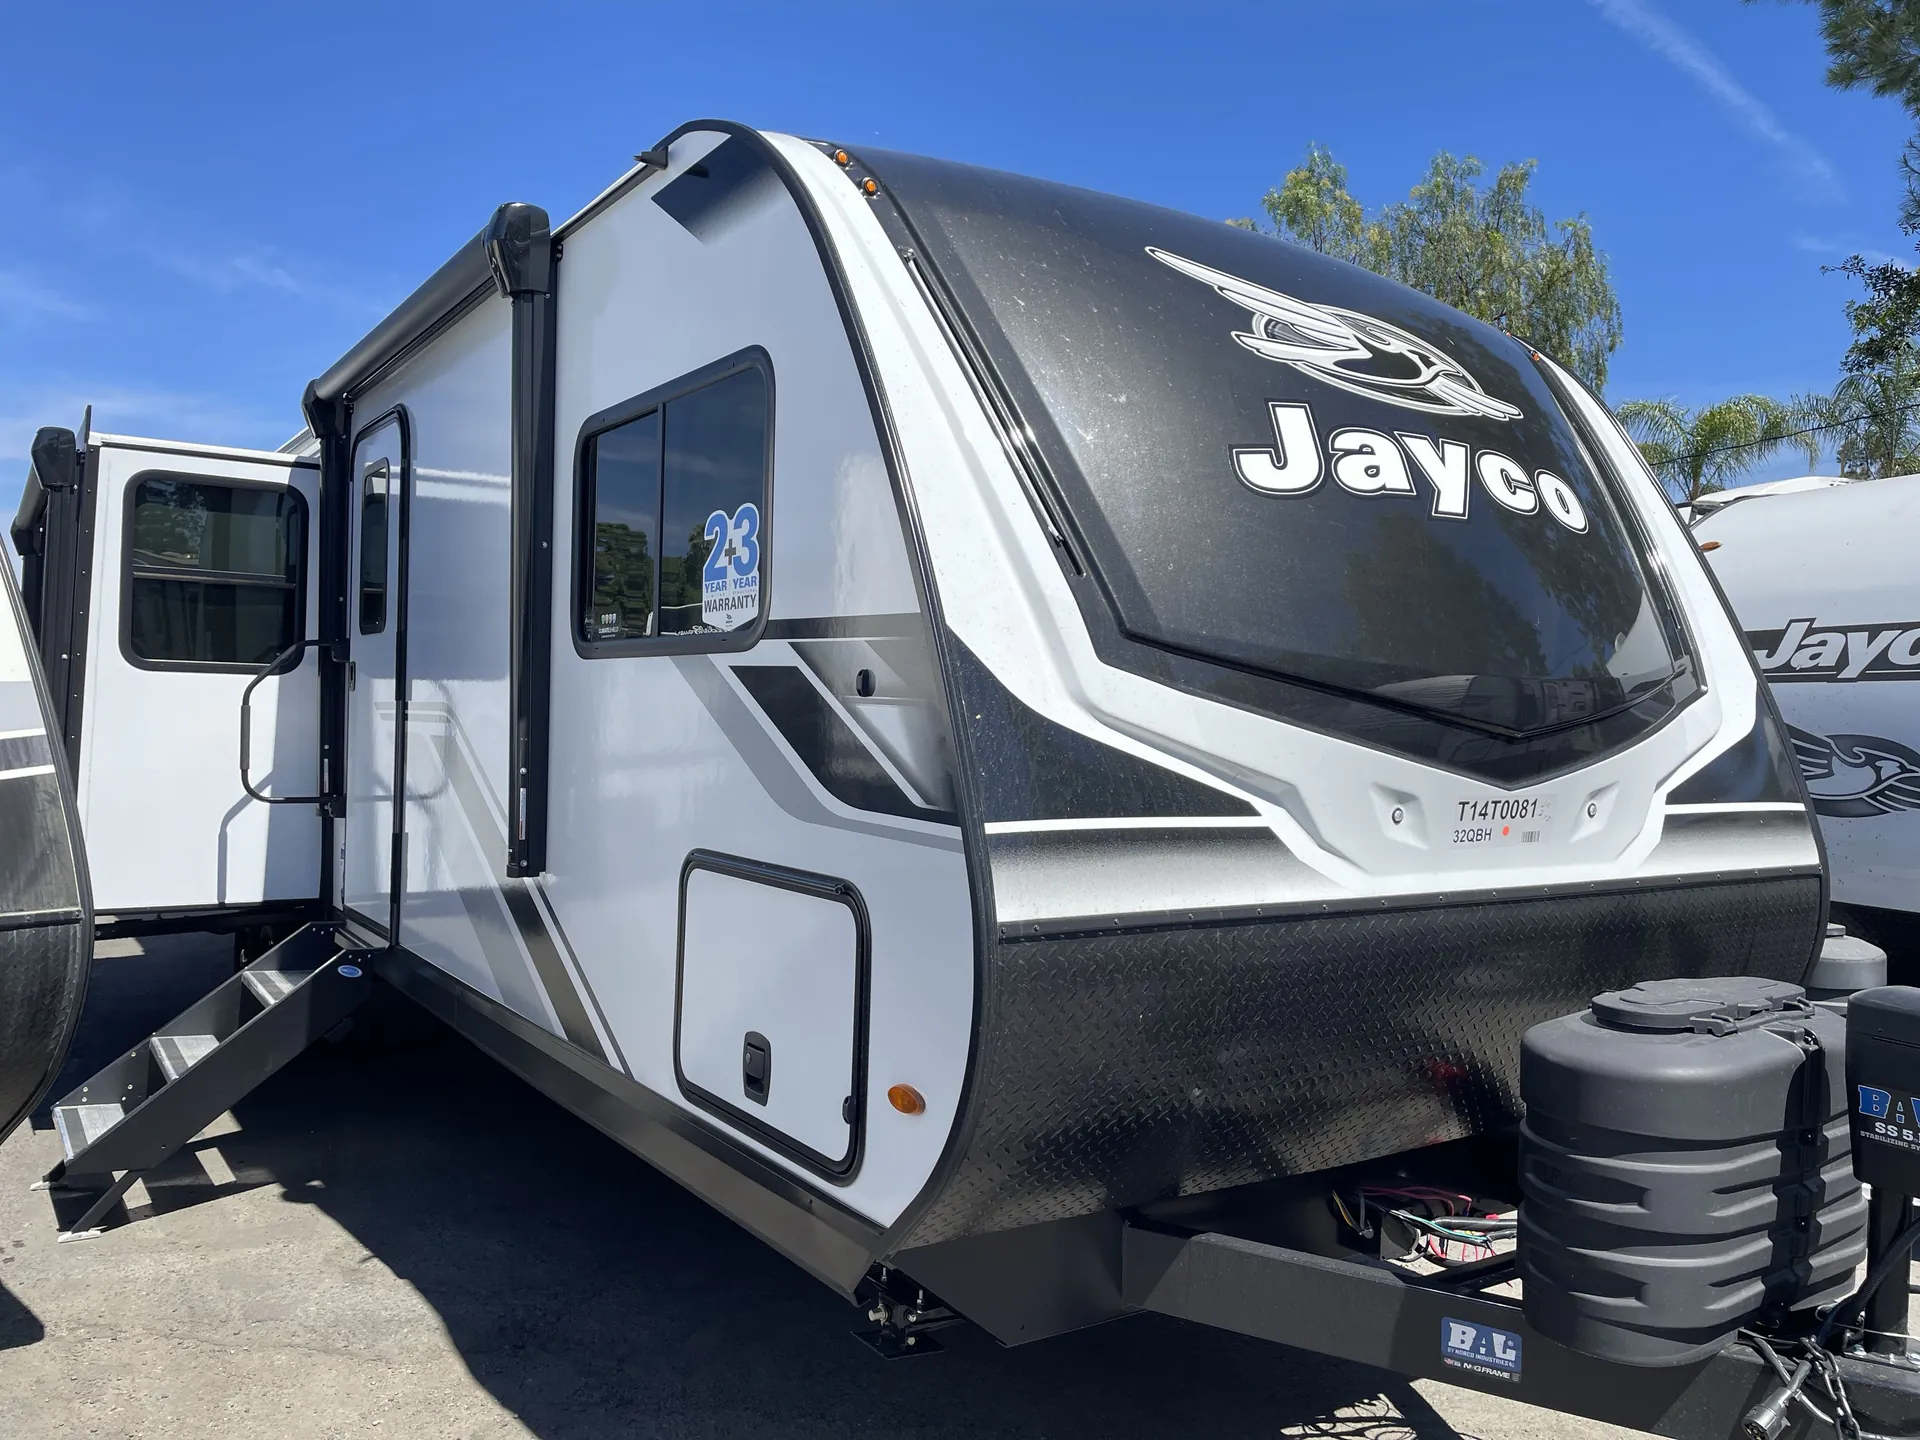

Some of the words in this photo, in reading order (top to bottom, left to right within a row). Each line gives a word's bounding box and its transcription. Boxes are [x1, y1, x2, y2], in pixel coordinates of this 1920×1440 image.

[1232, 401, 1589, 534] Jayco
[704, 581, 727, 594] YEAR
[732, 576, 757, 590] YEAR
[704, 594, 757, 614] WARRANTY
[1458, 798, 1538, 822] T14T0081
[1453, 828, 1492, 843] 32QBH
[1857, 1084, 1920, 1128] BA
[1875, 1121, 1899, 1137] SS
[1860, 1130, 1909, 1148] STABILIZING
[1475, 1353, 1510, 1367] INDUSTRIES
[1481, 1366, 1511, 1379] FRAME
